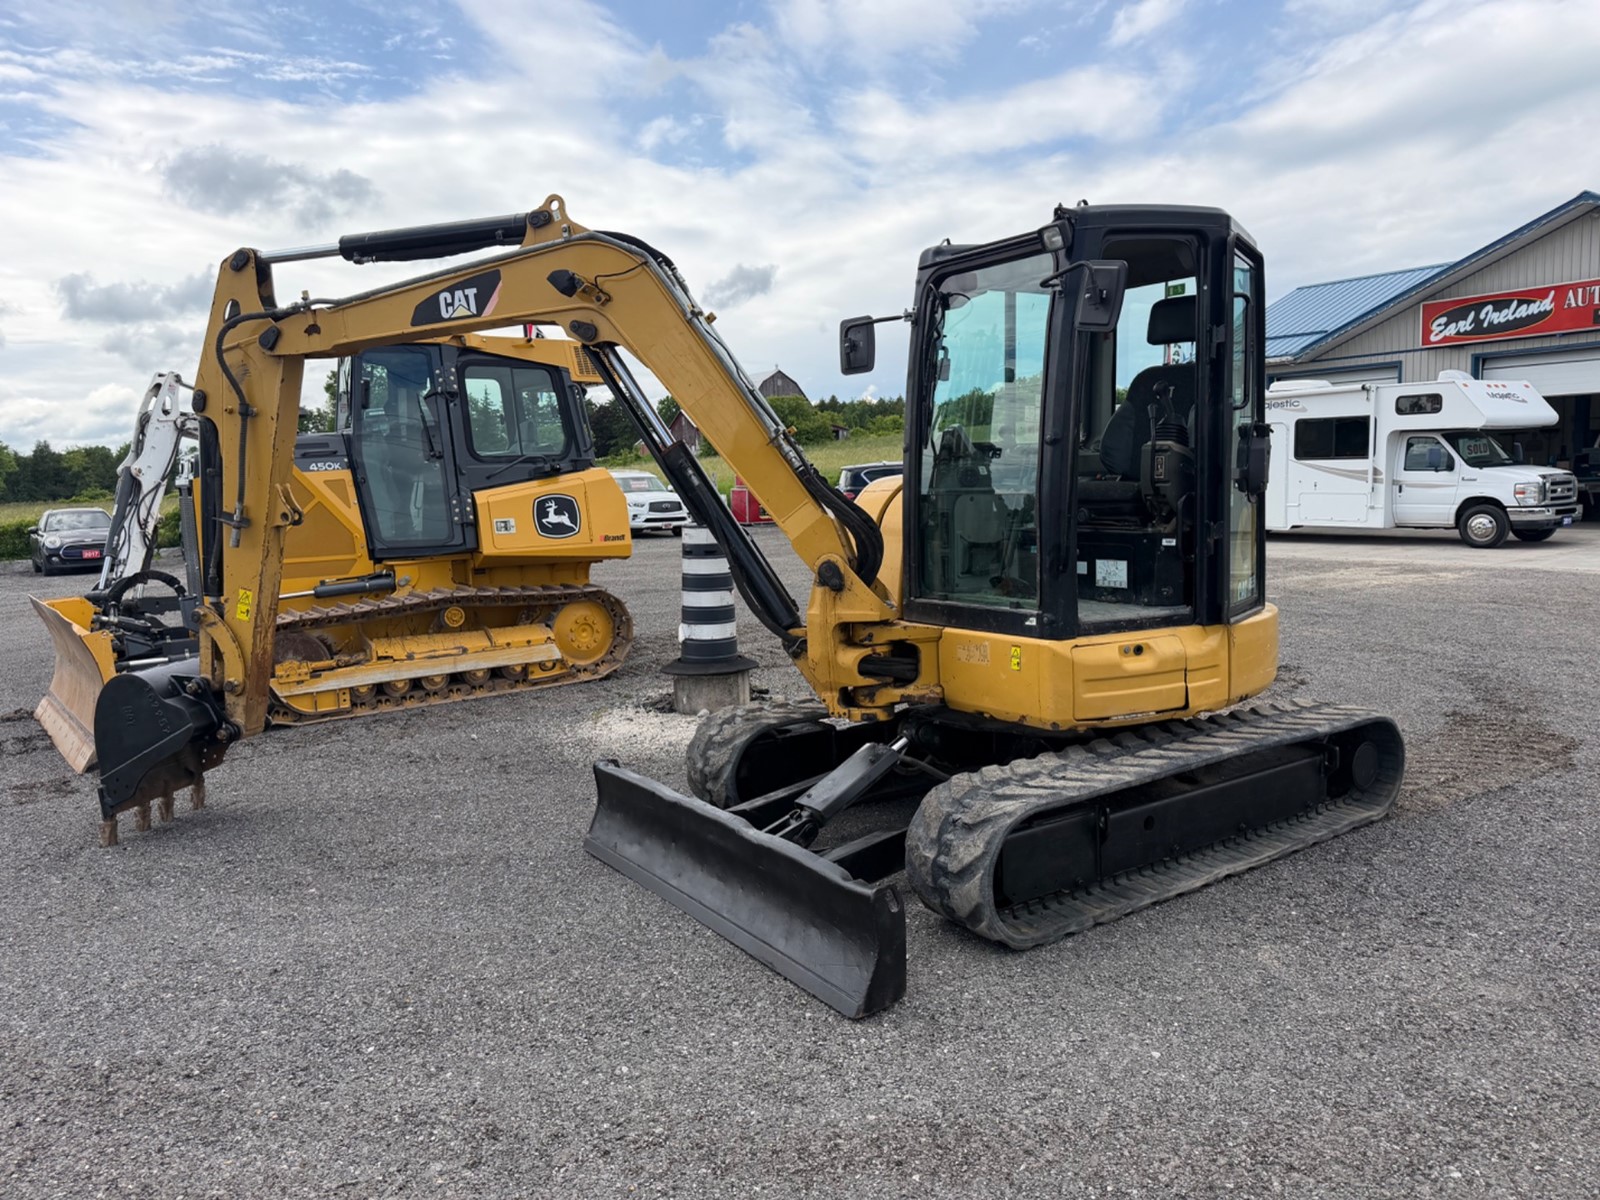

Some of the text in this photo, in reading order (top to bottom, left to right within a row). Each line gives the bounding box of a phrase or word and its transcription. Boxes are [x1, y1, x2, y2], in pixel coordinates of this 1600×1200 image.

[438, 287, 477, 319] CAT
[1430, 311, 1475, 342] Earl
[1479, 290, 1555, 328] Ireland
[1467, 443, 1488, 455] SOLD
[309, 462, 342, 471] 450K
[604, 534, 625, 542] Brandt
